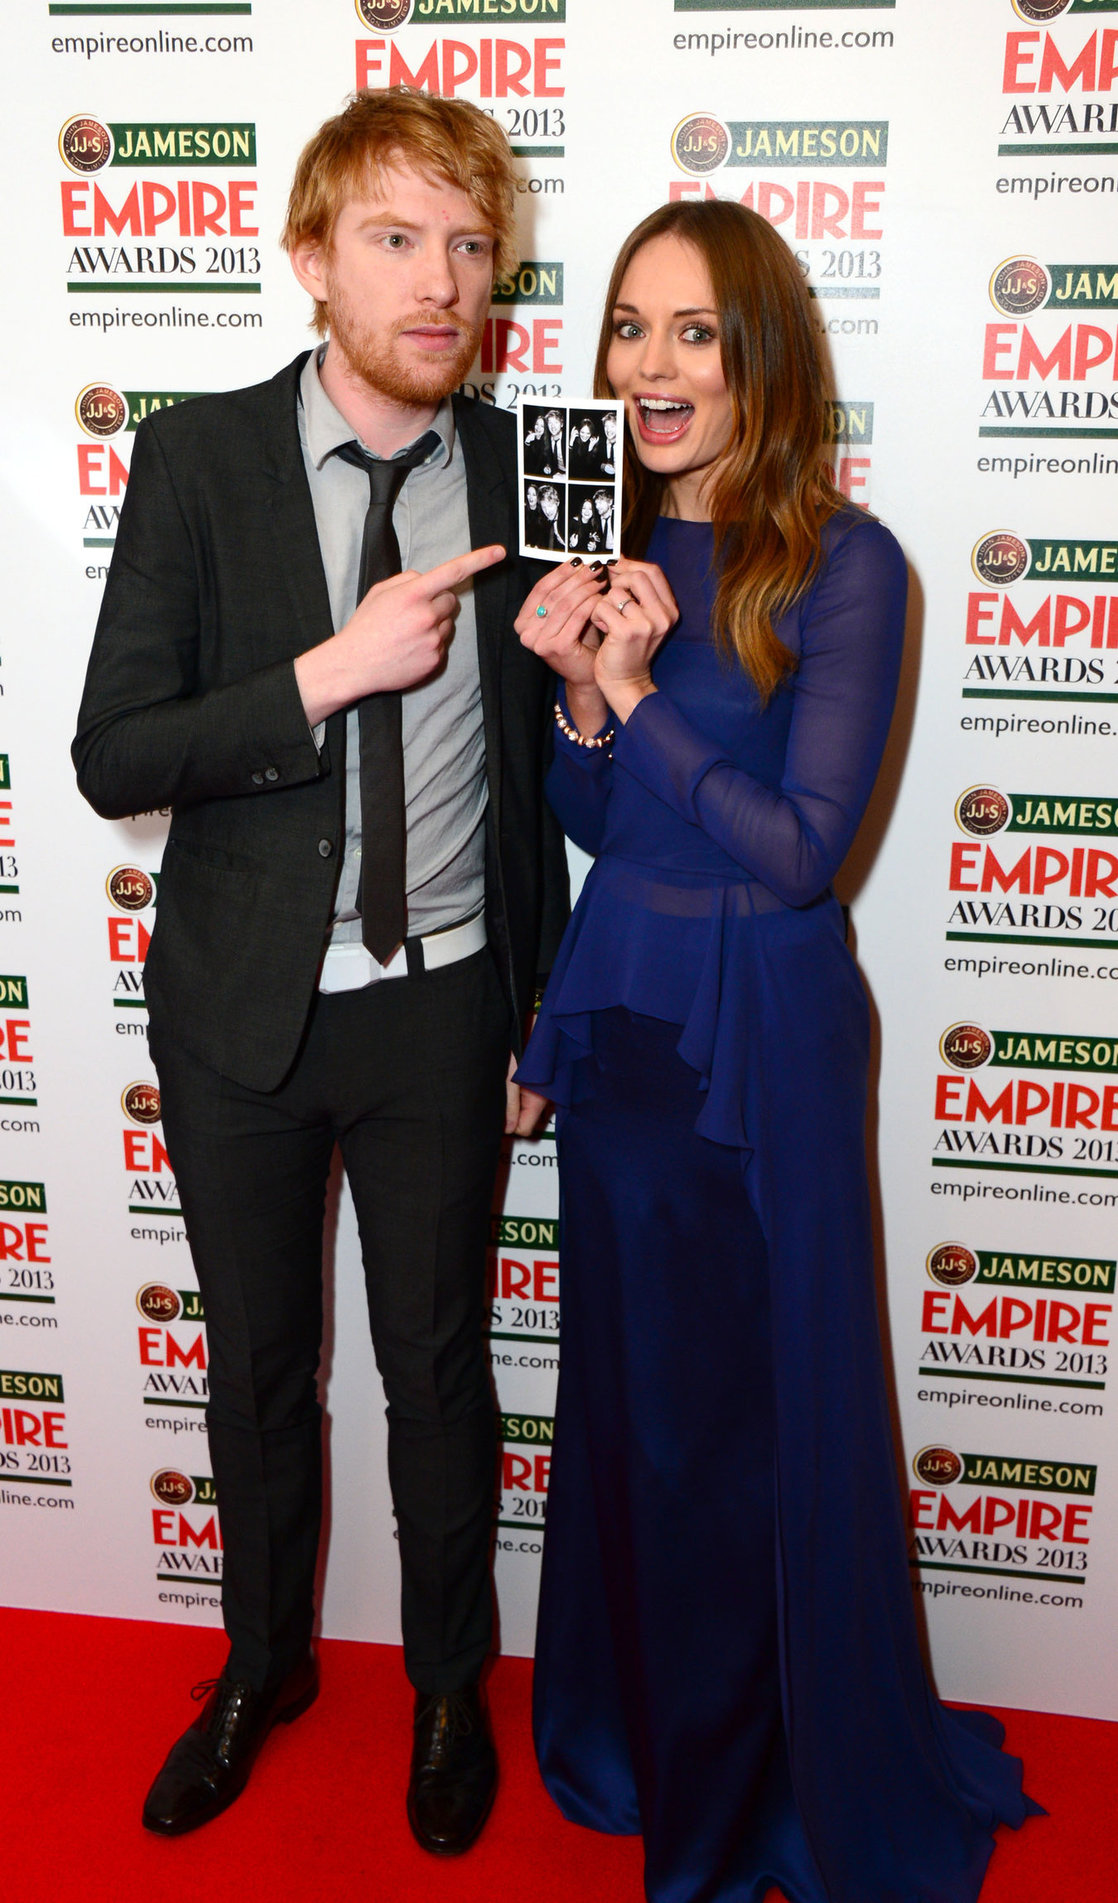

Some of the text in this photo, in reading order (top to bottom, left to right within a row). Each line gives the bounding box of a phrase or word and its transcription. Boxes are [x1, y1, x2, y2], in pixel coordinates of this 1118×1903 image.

[51, 30, 253, 59] empireonline.com
[673, 25, 894, 56] empireonline.com
[355, 38, 566, 98] EMPIRE
[1002, 28, 1118, 94] EMP
[507, 108, 566, 137] 2013
[998, 103, 1118, 134] AWAR
[118, 130, 250, 158] JAMESON
[737, 129, 881, 157] JAMESON
[996, 172, 1118, 200] empireon
[60, 180, 259, 237] EMPIRE
[669, 181, 885, 240] PIRE
[66, 246, 261, 274] AWARDS 2013
[820, 250, 882, 278] 2013
[69, 306, 263, 333] empireonline.com
[480, 319, 563, 374] IRE
[982, 323, 1118, 381] EMP
[977, 453, 1118, 479] empireonlin
[1035, 547, 1118, 573] JAME
[965, 592, 1118, 649] EMPI
[963, 654, 1104, 684] AWARDS
[960, 714, 1117, 738] empireonline.
[1016, 801, 1118, 828] JAMES
[949, 842, 1118, 899] EMPIR
[946, 900, 1118, 932] AWARDS 20
[944, 956, 1118, 980] empireonline.co
[0, 1069, 37, 1092] 013
[934, 1075, 1118, 1132] EMPIRE
[933, 1128, 1118, 1163] AWARDS 201
[930, 1181, 1118, 1207] empireonline.com
[8, 1268, 54, 1290] 2013
[983, 1257, 1110, 1287] JAMESON
[511, 1307, 560, 1330] 2013
[921, 1290, 1112, 1347] EMPIRE
[920, 1341, 1108, 1376] AWARDS 2013
[1, 1375, 59, 1397] ESON
[917, 1389, 1103, 1416] empireonline.com
[0, 1407, 69, 1450] IRE
[26, 1452, 71, 1474] 2013
[968, 1460, 1091, 1489] JAMESON
[1, 1490, 75, 1510] line.com
[512, 1497, 546, 1518] 201
[910, 1489, 1093, 1545] EMPIRE
[911, 1535, 1088, 1571] AWARDS 2013
[914, 1581, 1083, 1608] mpireonline.com
